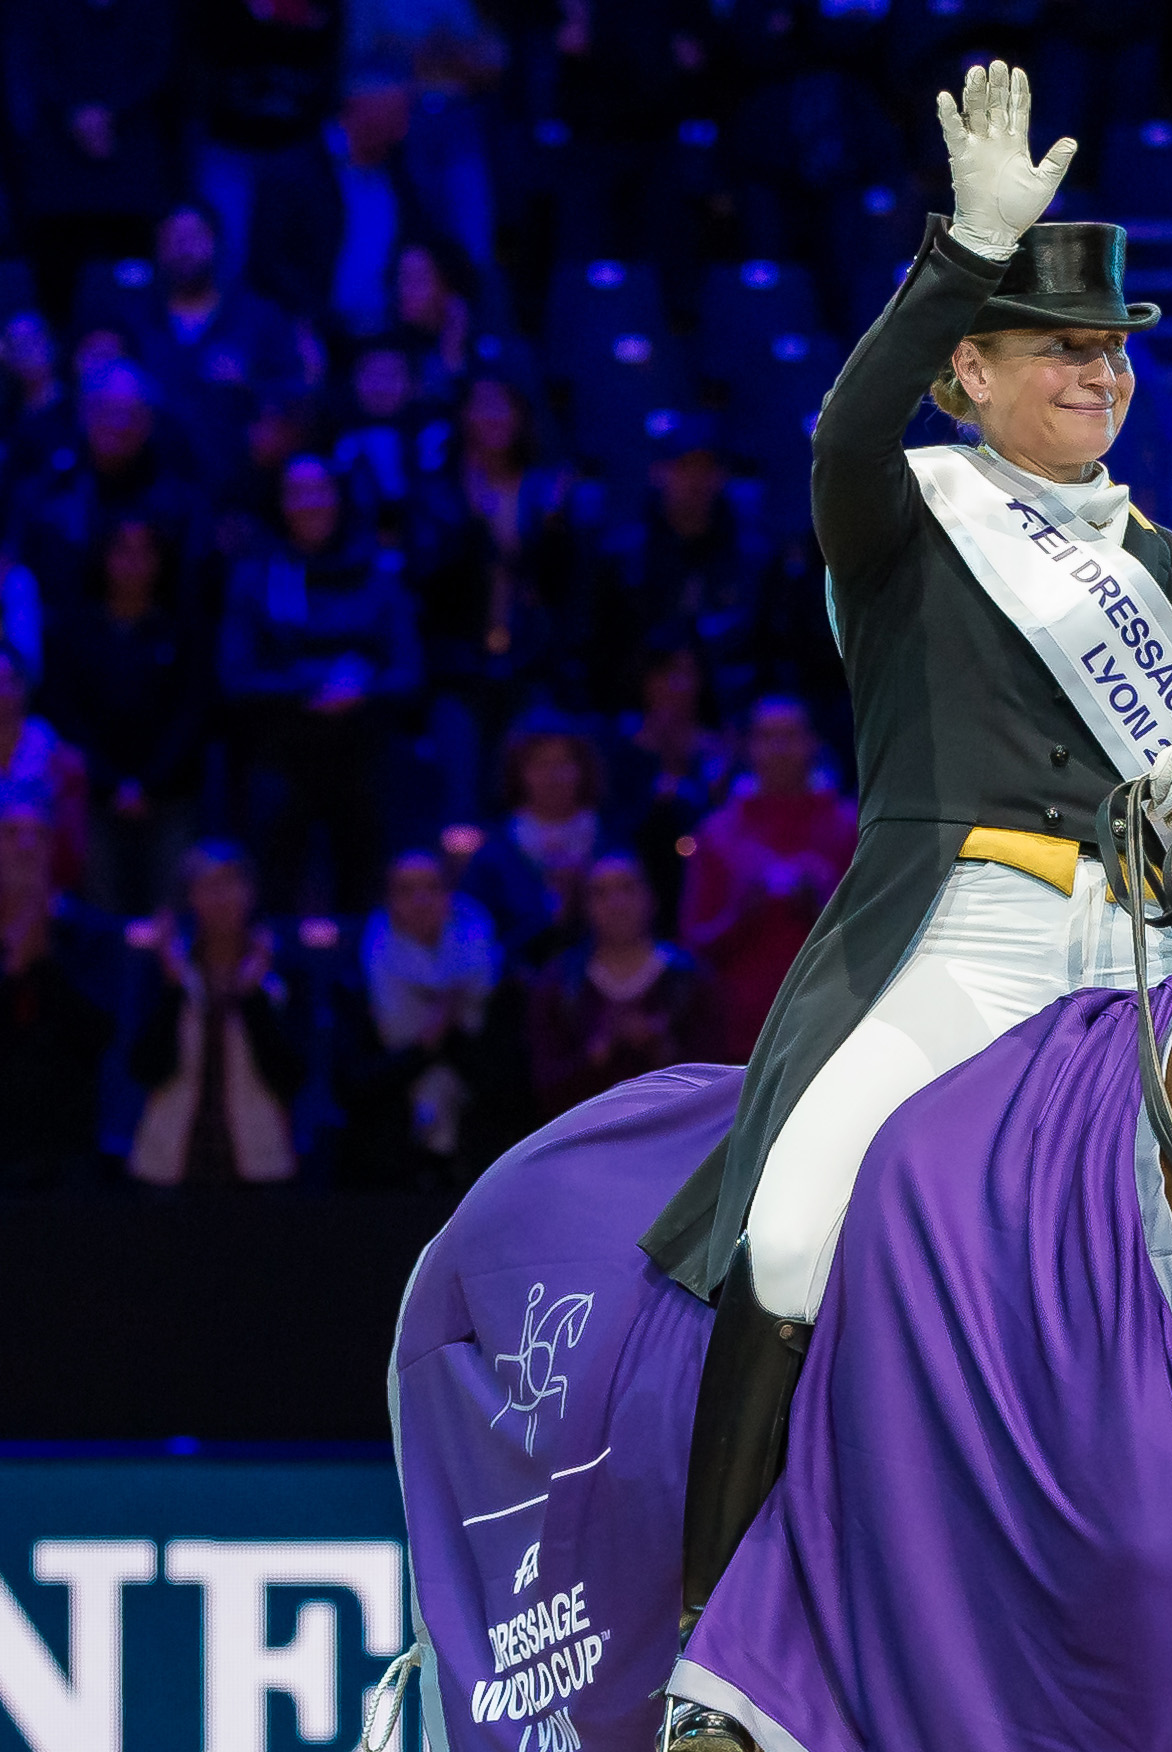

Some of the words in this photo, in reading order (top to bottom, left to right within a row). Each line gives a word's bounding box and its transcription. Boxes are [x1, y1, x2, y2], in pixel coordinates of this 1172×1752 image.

[1006, 498, 1078, 562] FEI
[1081, 642, 1160, 741] LYON
[488, 1581, 591, 1674] DRESSAGE
